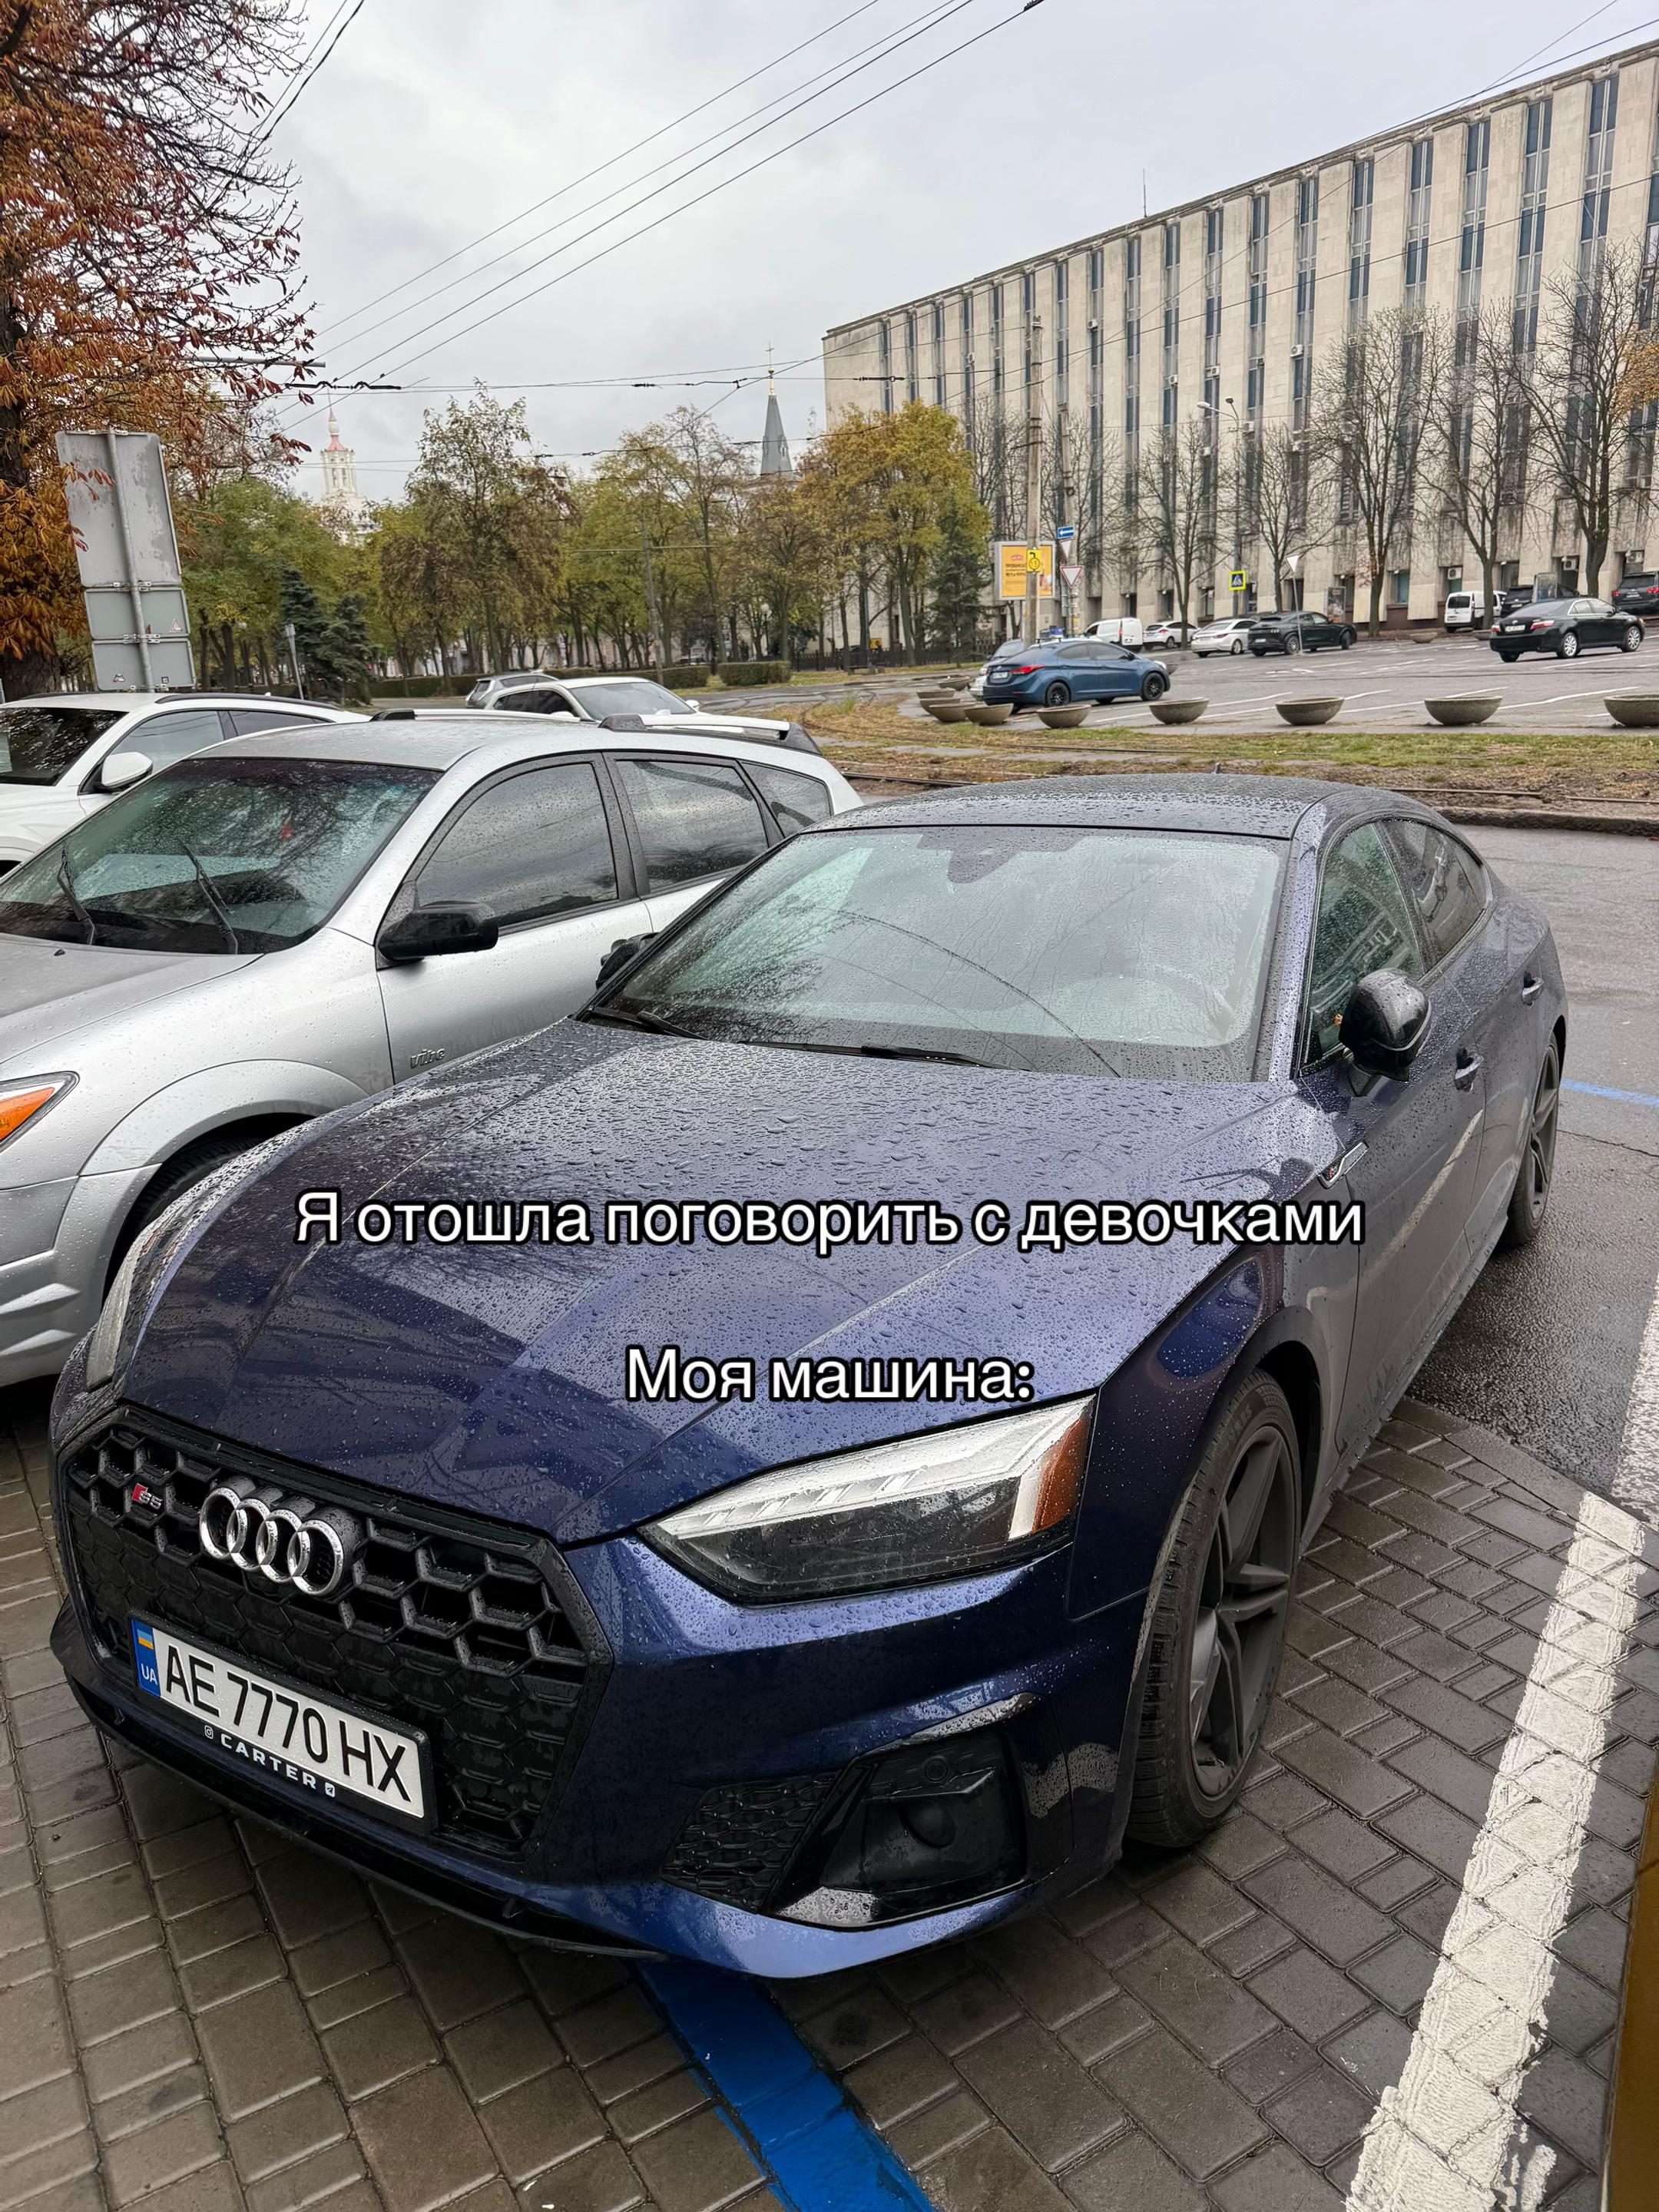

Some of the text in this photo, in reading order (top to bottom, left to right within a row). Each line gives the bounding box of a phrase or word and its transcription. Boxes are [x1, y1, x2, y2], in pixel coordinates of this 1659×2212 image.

[141, 1663, 158, 1686] UA
[166, 1644, 412, 1803] AE 7770 HX
[220, 1733, 316, 1790] CARTER
